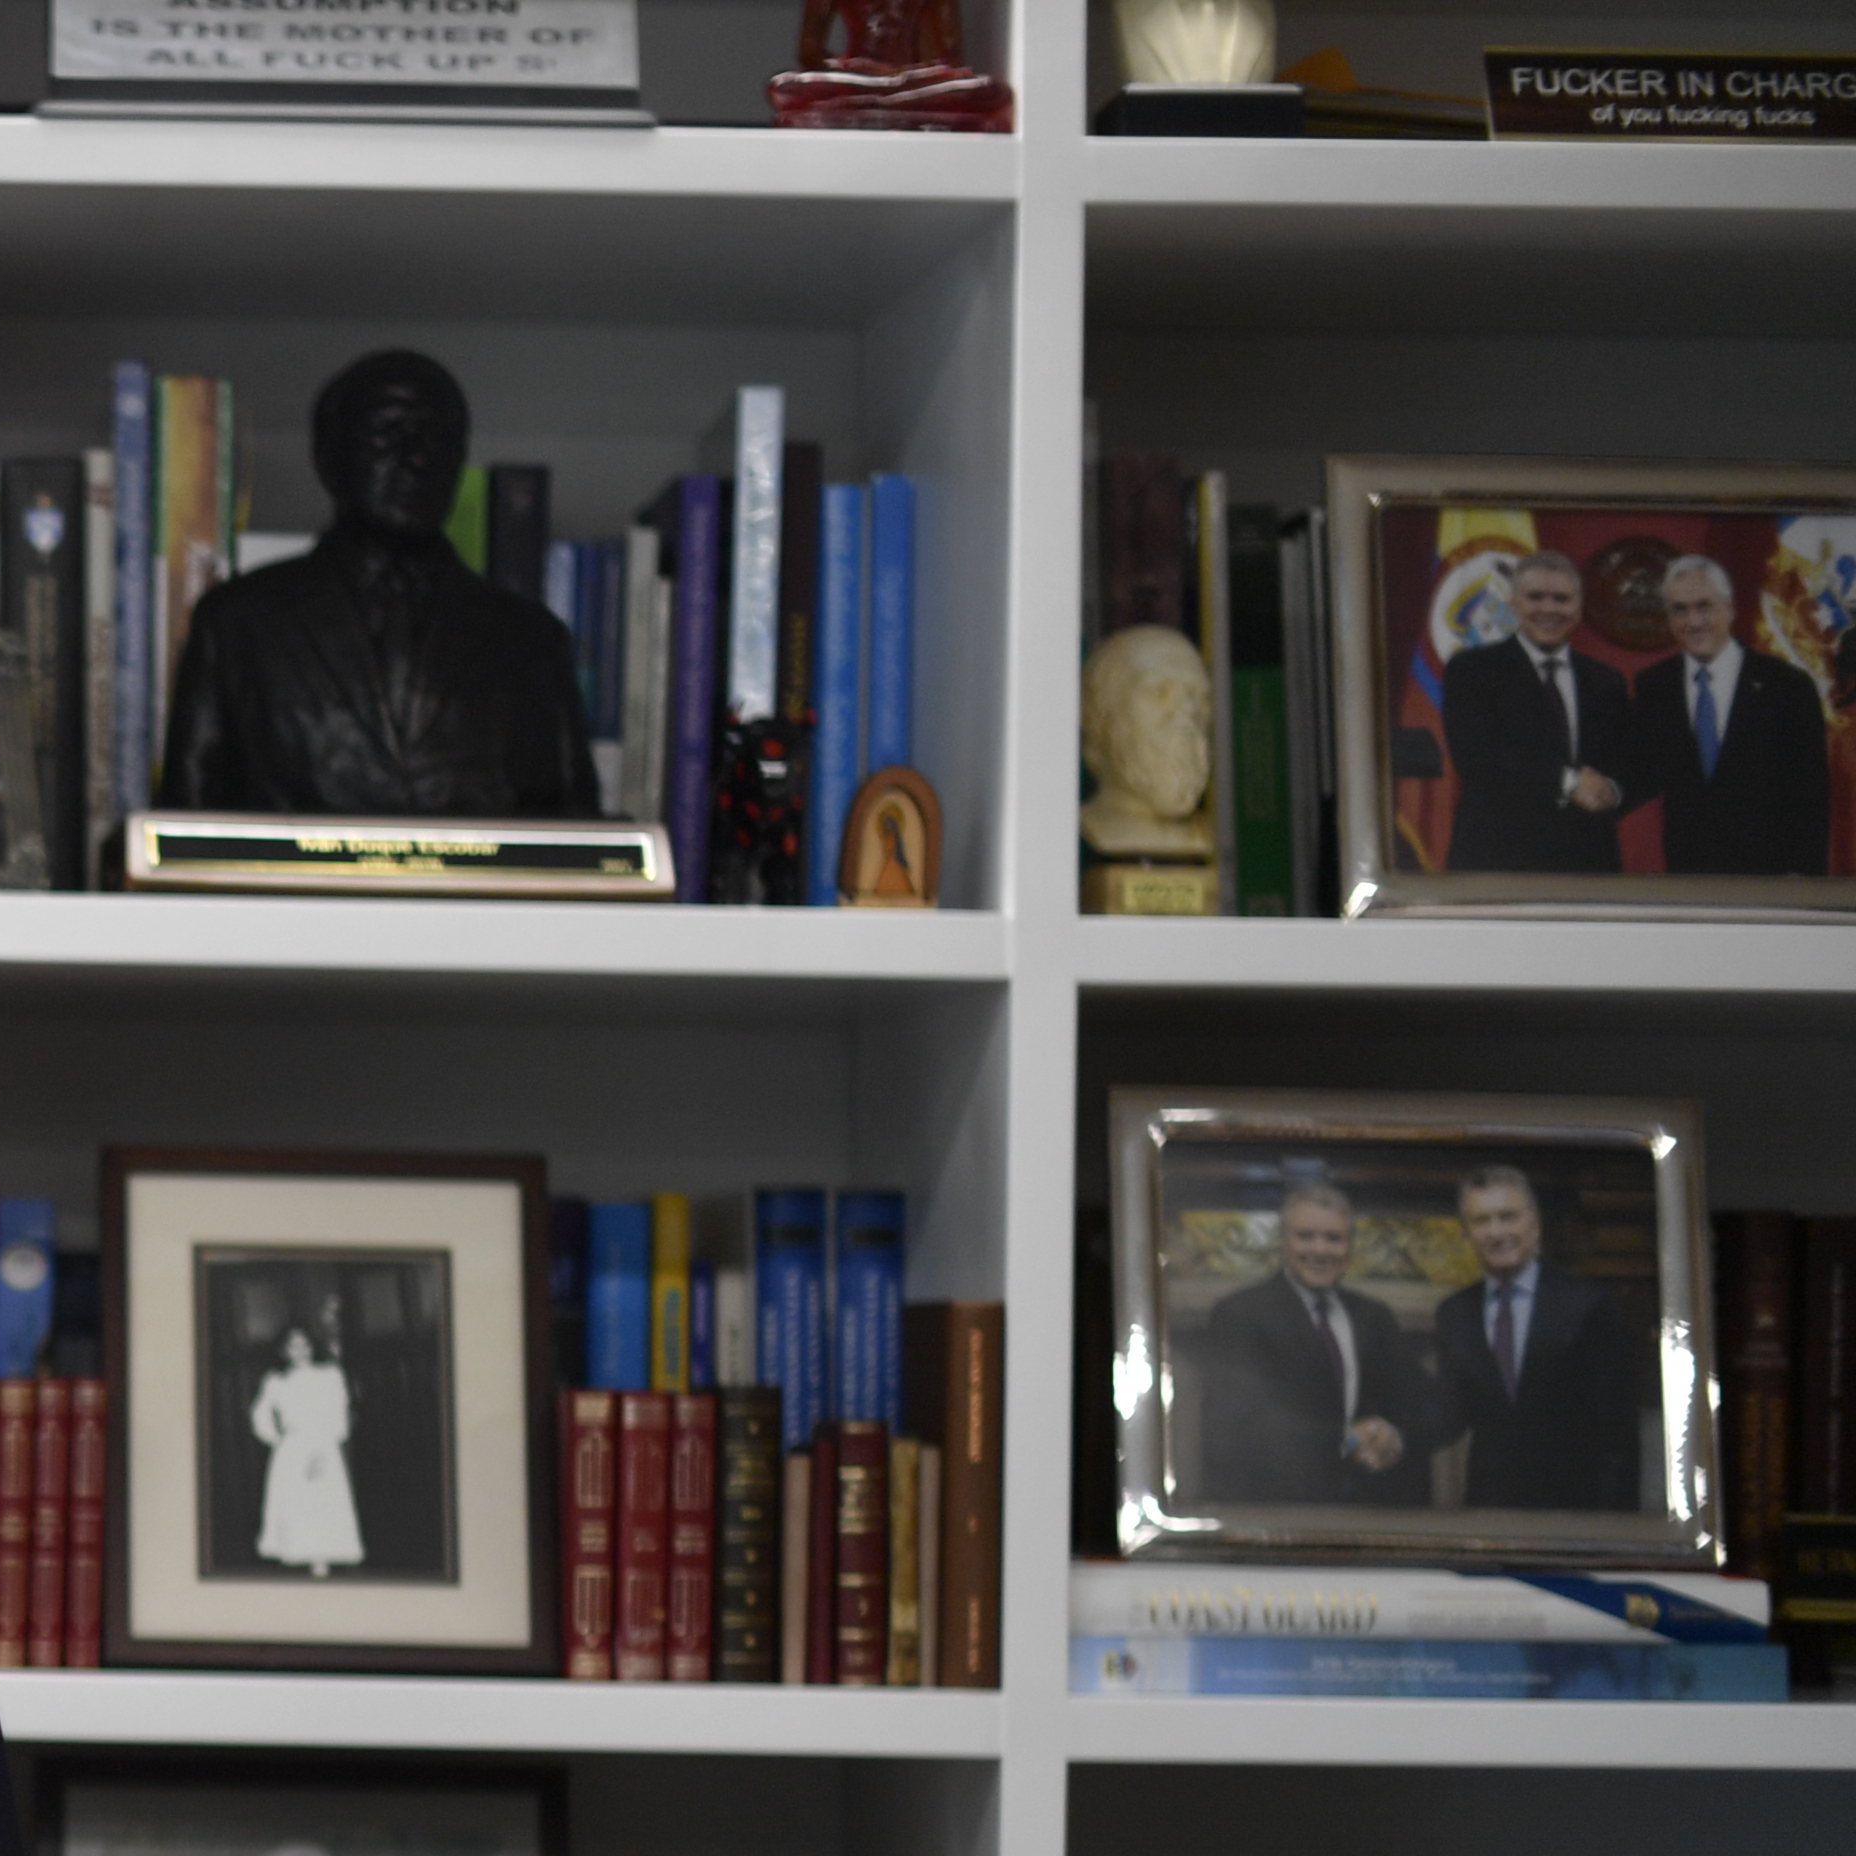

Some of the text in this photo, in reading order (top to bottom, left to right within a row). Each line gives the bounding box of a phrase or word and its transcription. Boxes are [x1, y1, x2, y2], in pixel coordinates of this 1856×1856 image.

[91, 18, 594, 46] IS THE MOTHER OF
[146, 49, 243, 67] ALL
[263, 51, 403, 69] FUCK
[427, 54, 497, 71] UP
[1510, 66, 1667, 98] FUCKER
[1677, 69, 1715, 98] IN
[1592, 102, 1816, 129] of you fucking fucks
